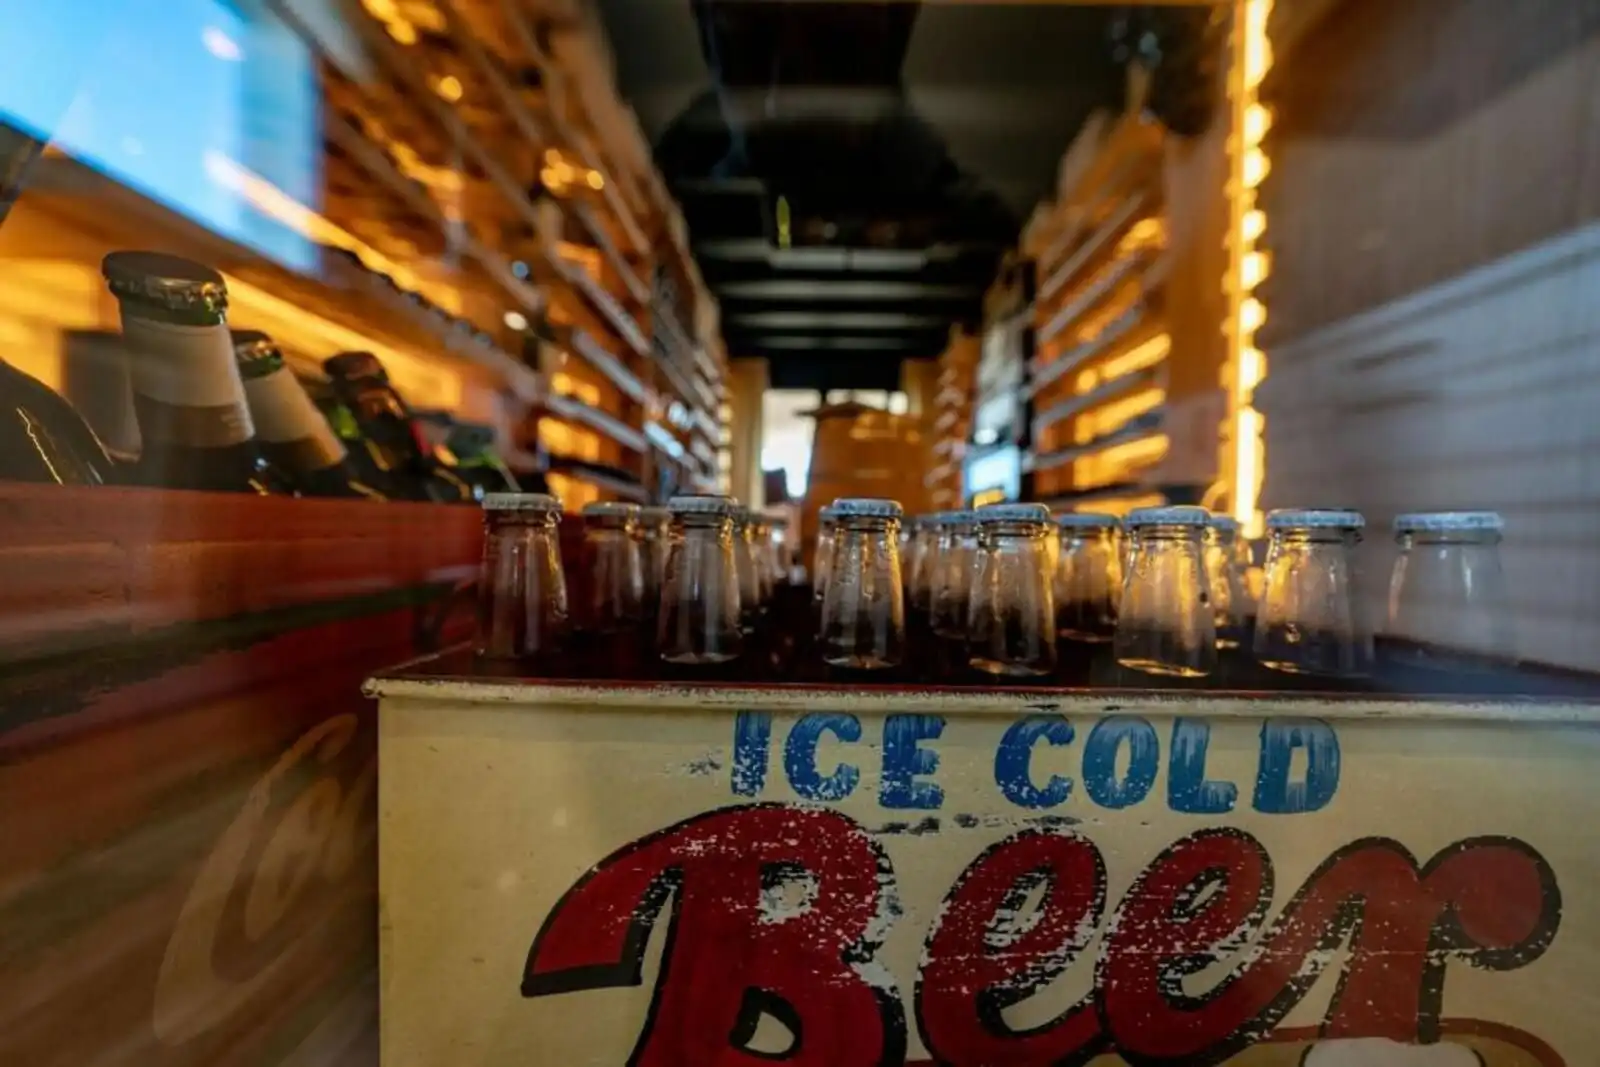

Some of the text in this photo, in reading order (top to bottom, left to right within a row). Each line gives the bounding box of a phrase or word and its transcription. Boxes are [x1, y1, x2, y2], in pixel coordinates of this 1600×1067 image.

[730, 710, 1341, 814] ICE COLD
[520, 801, 1562, 1067] Beer
